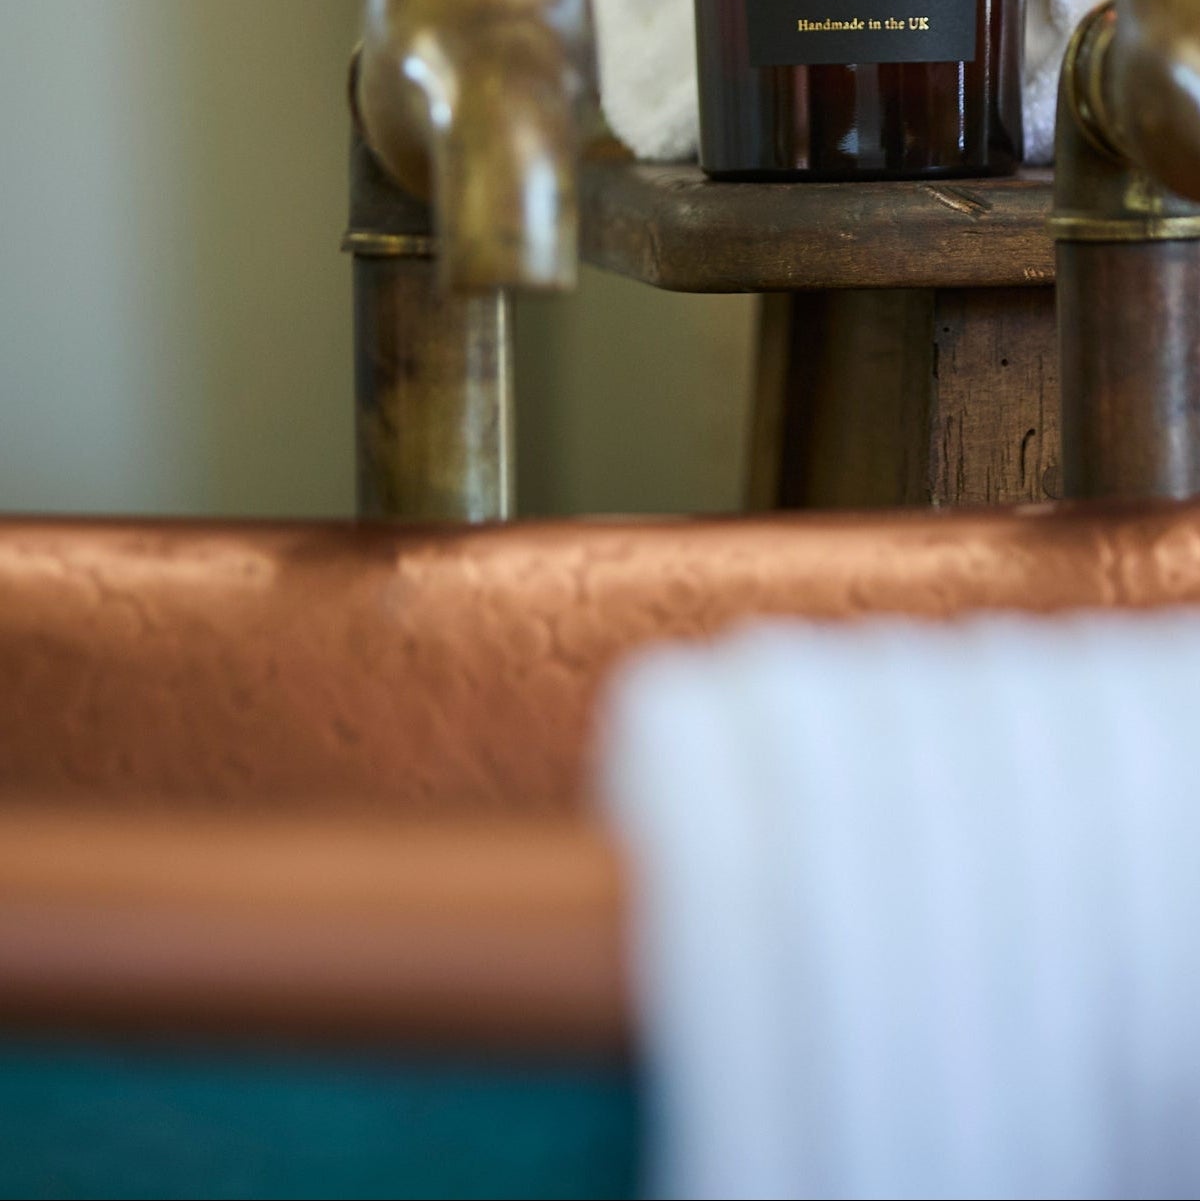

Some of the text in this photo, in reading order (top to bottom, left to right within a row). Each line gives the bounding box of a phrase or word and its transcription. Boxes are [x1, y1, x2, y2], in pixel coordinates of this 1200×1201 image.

[797, 17, 929, 32] Handmade in the UK
